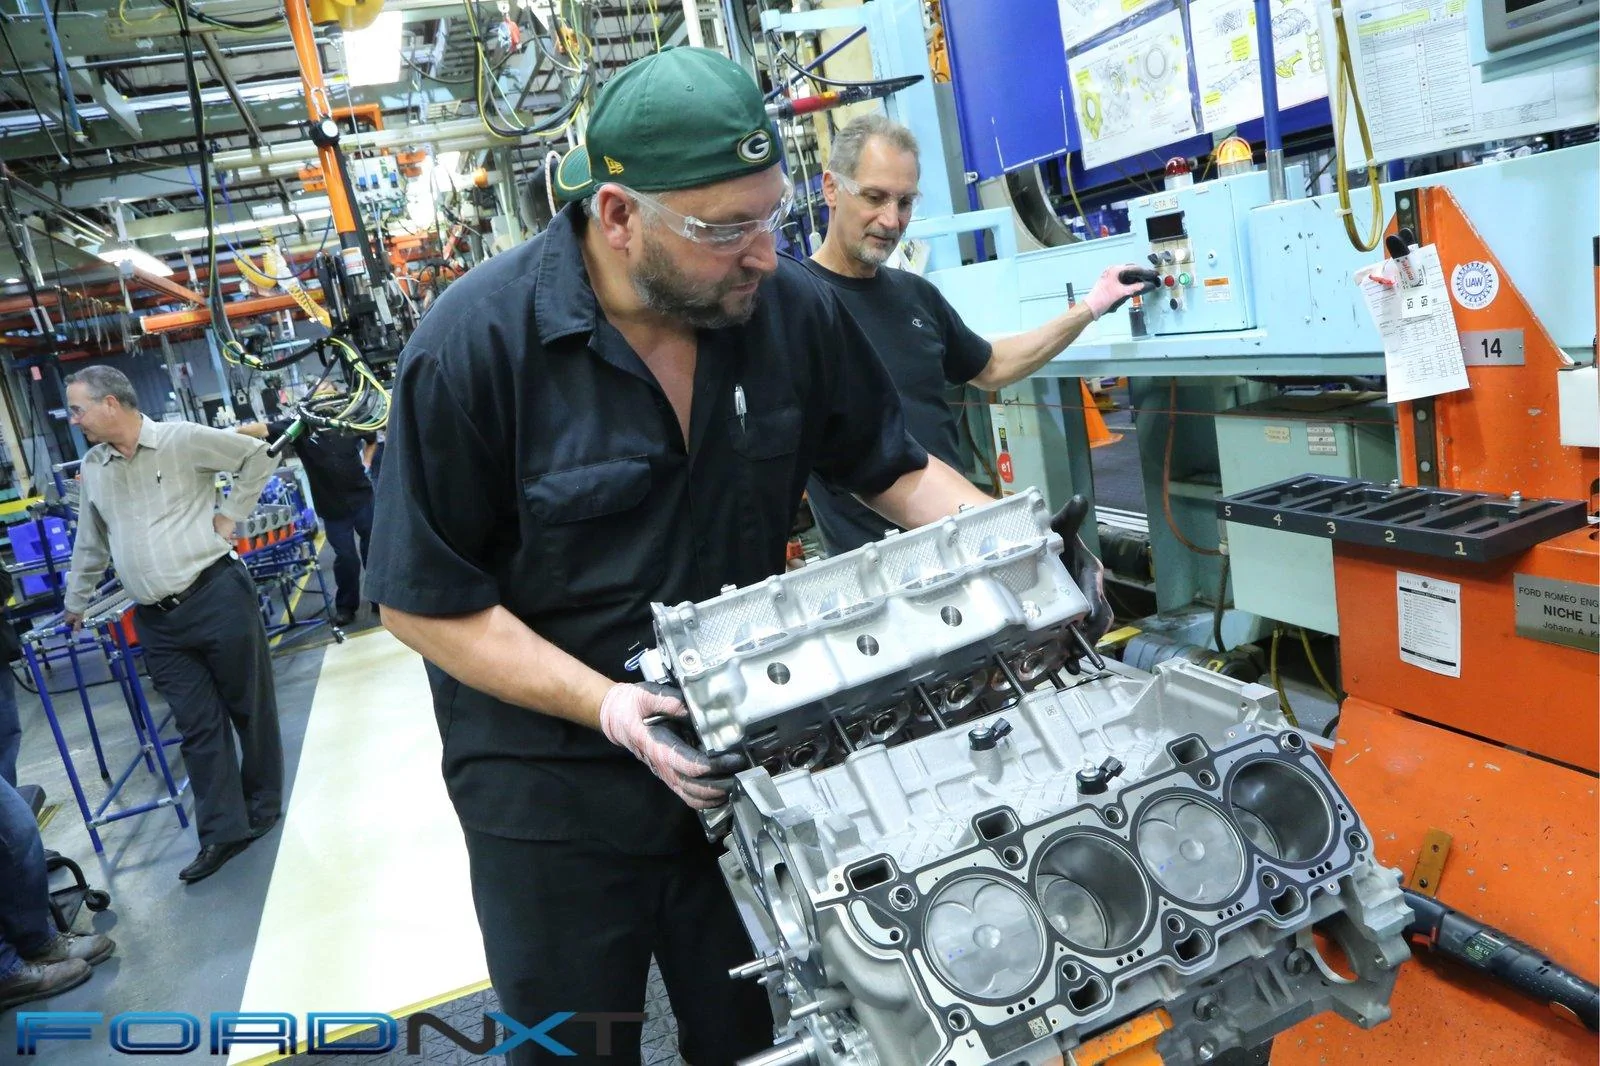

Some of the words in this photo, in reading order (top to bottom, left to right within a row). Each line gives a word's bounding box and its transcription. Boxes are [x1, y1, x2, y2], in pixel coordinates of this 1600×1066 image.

[739, 132, 770, 161] G
[1465, 276, 1484, 288] UAW
[1481, 337, 1503, 358] 14
[1224, 505, 1232, 517] 5
[1273, 513, 1283, 527] 4
[1326, 521, 1336, 534] 3
[1384, 529, 1397, 543] 2
[1454, 541, 1468, 556] 1
[1518, 586, 1542, 598] FORD
[1544, 591, 1577, 604] ROMEO
[1543, 604, 1583, 622] NICHE
[1589, 613, 1600, 625] L
[1543, 621, 1574, 633] Johann
